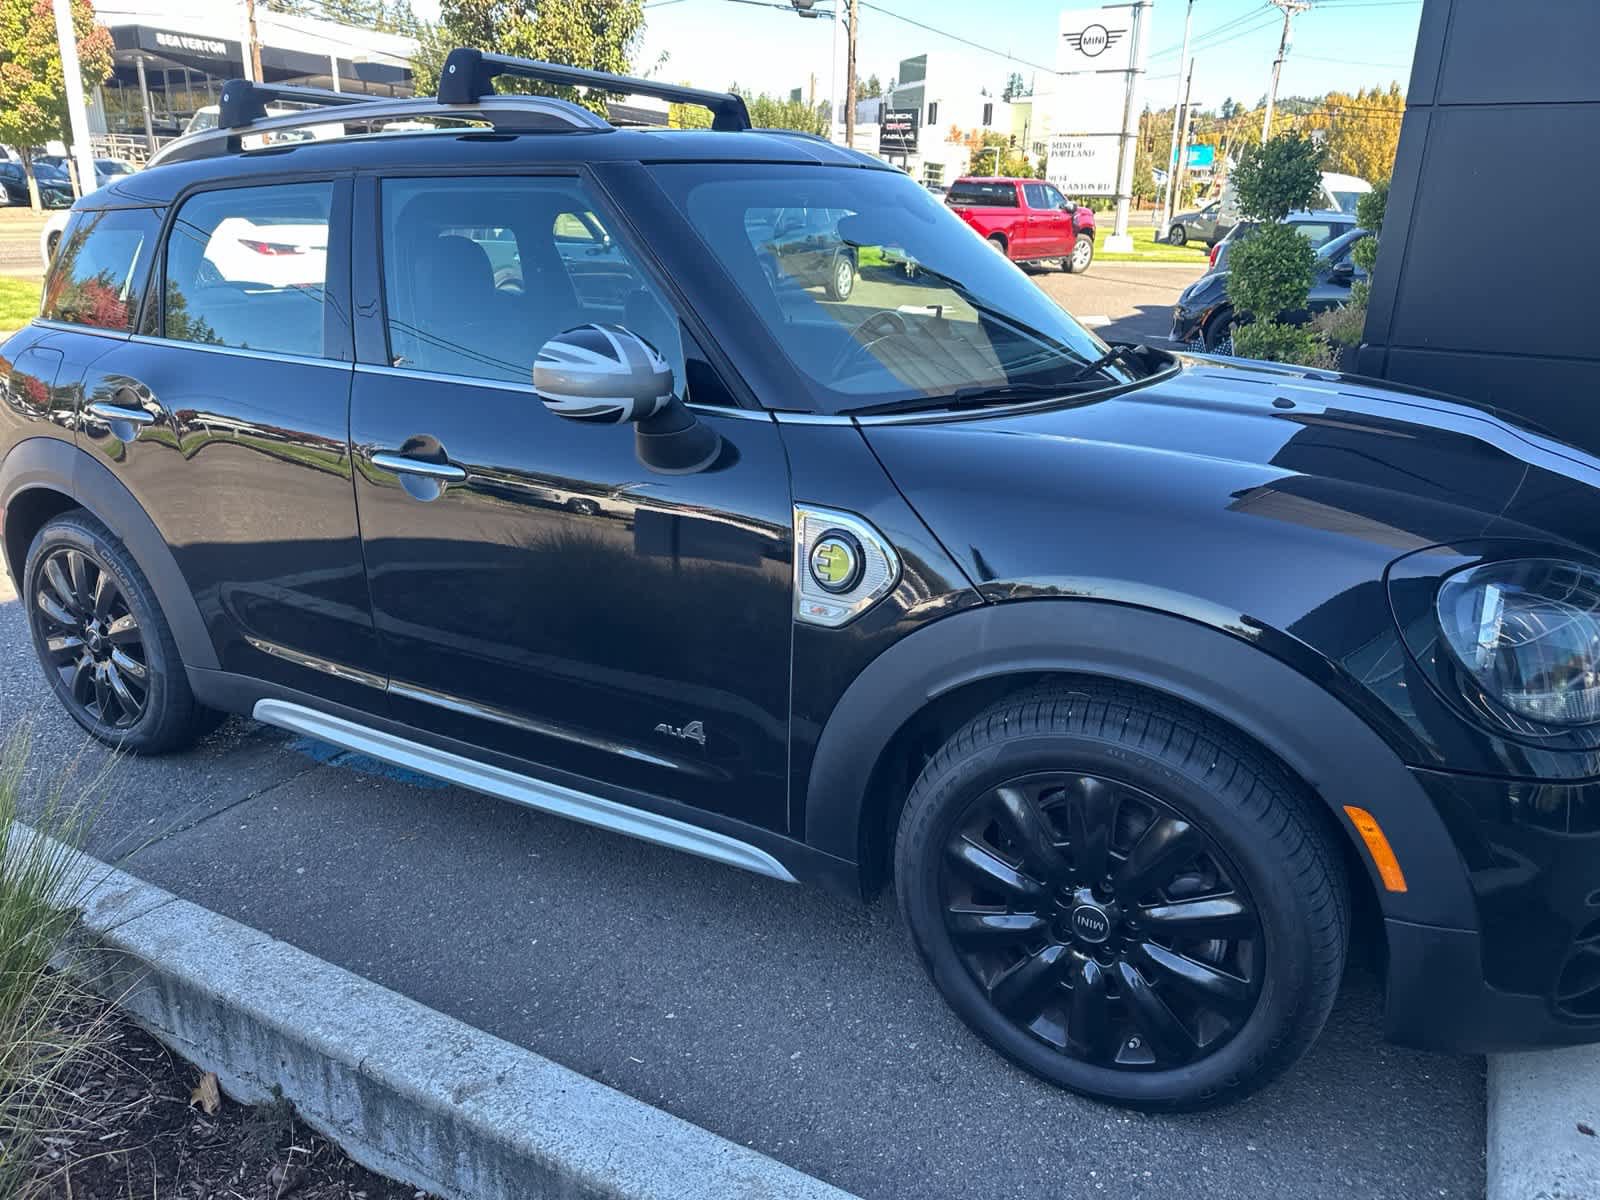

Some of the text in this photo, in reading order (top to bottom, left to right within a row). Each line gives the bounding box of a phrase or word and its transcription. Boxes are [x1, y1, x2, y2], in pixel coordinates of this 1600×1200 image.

[156, 33, 226, 55] BEAVERTON
[1083, 36, 1105, 46] MINI
[1050, 150, 1096, 158] PORTLAND
[1076, 915, 1105, 932] MINI
